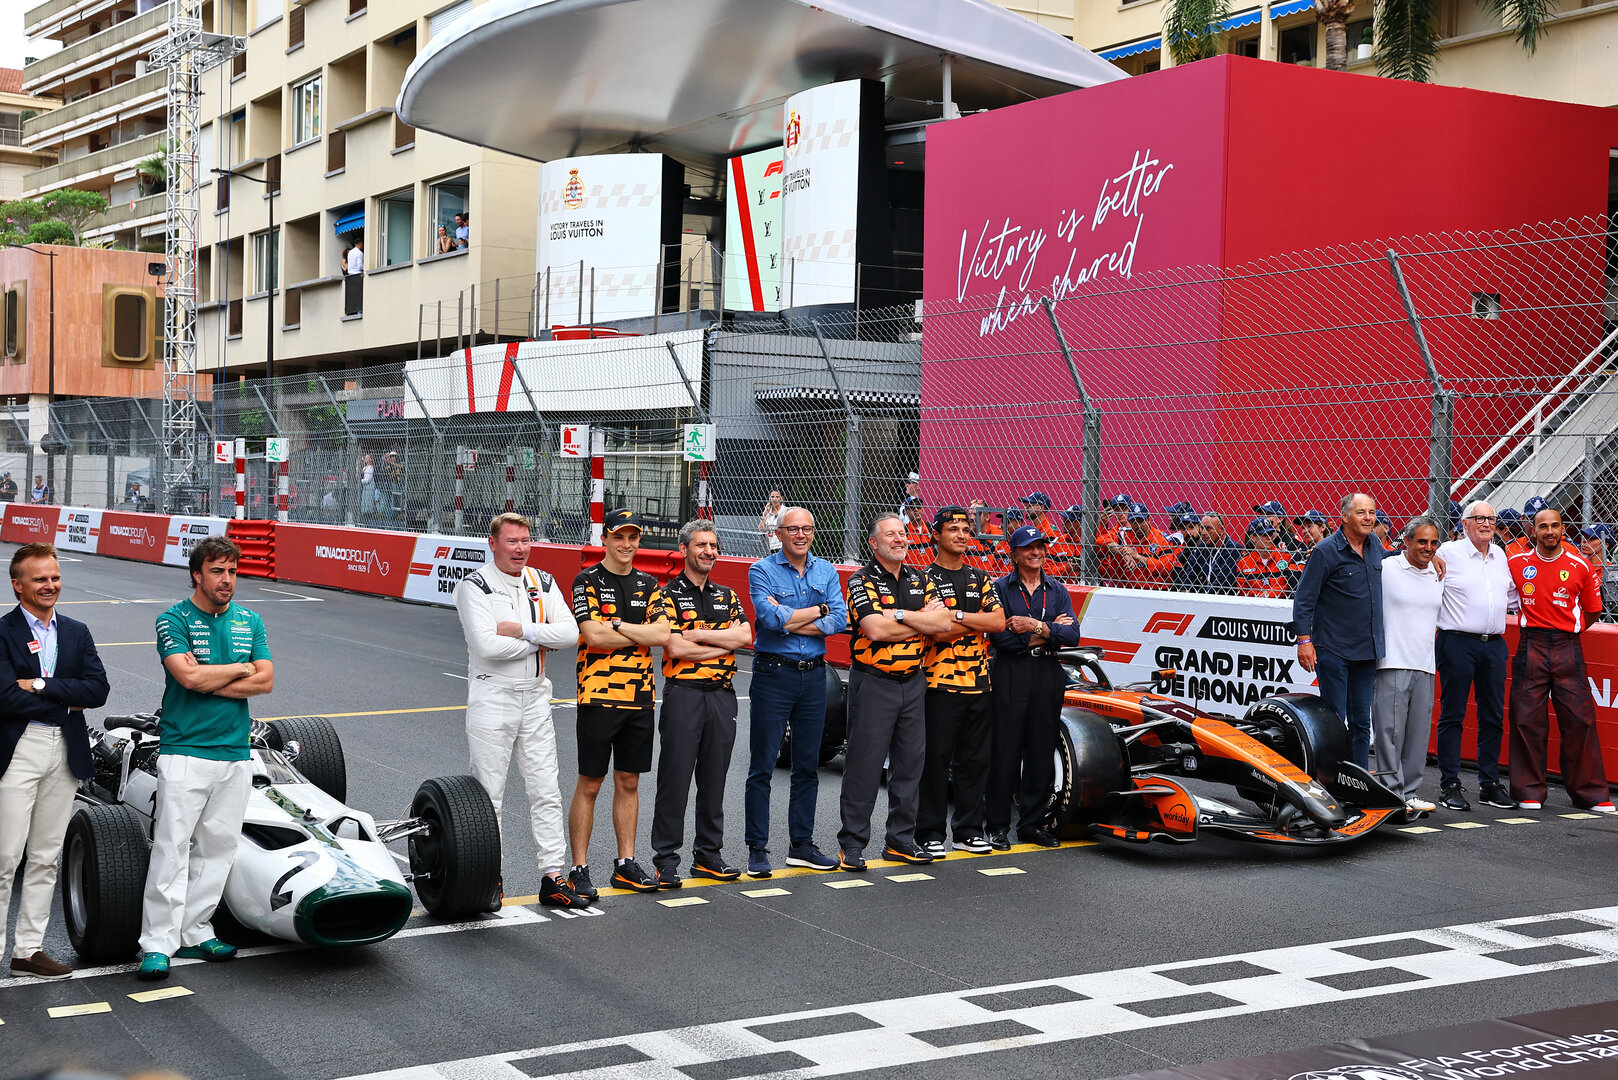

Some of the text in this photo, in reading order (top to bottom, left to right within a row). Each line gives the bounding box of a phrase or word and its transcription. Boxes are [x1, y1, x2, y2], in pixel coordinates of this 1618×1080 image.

[550, 219, 604, 231] VICTORY TRAVELS IN
[550, 227, 603, 241] LOUIS VUITTON
[956, 148, 1174, 304] Victory is better
[979, 213, 1144, 338] when shared
[434, 546, 450, 559] F1
[455, 549, 485, 561] LOUIS VUITTON
[438, 565, 462, 580] GRAND
[438, 580, 447, 593] DE
[1142, 612, 1195, 636] F1
[1212, 620, 1254, 641] LOUIS
[1155, 646, 1295, 685] GRAND PRIX
[1157, 674, 1184, 698] DE
[1093, 702, 1113, 712] MILLE
[1251, 703, 1293, 723] P ZERO
[1163, 812, 1190, 826] workday
[270, 850, 320, 912] 2
[1397, 1033, 1618, 1072] FIA Formula
[1428, 1058, 1552, 1080] World
